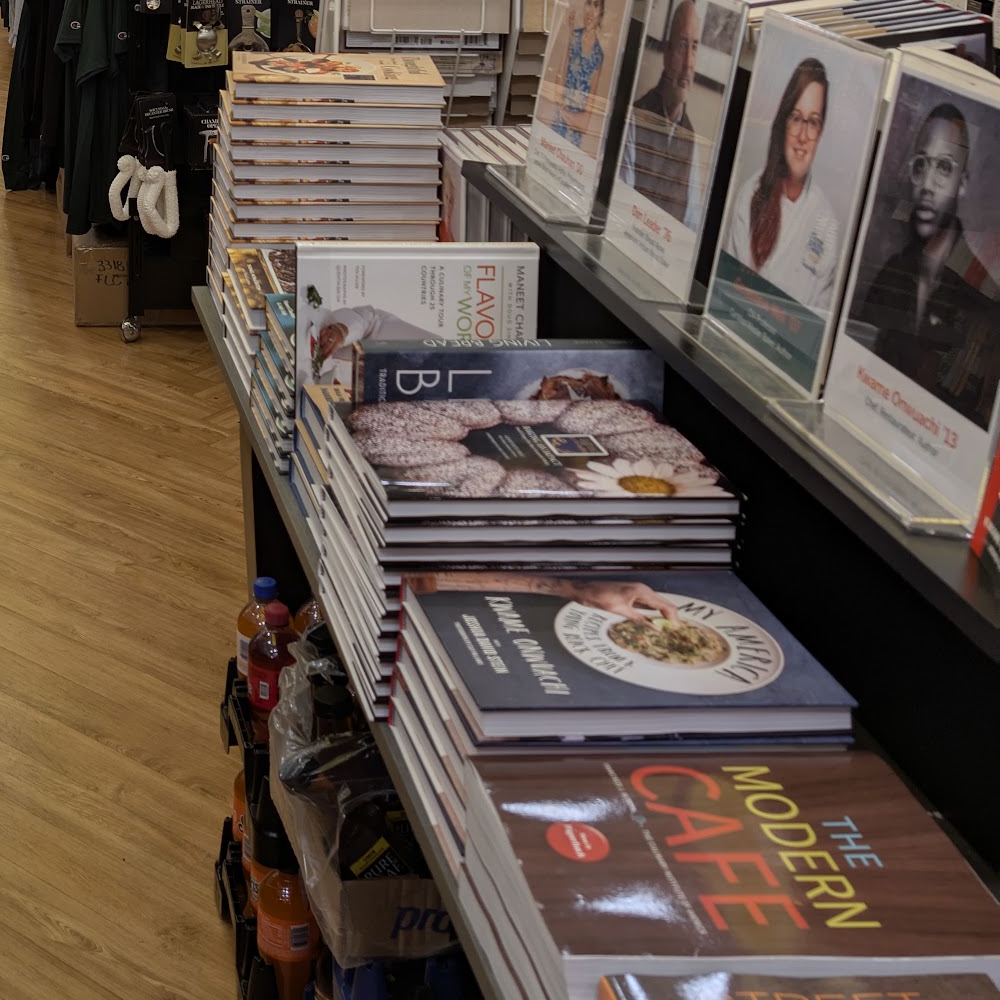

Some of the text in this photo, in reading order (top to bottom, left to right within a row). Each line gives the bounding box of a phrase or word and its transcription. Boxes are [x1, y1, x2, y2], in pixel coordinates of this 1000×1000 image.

[96, 260, 126, 272] 3318
[456, 265, 473, 340] OF MY WOR
[475, 265, 496, 339] FLAVO
[516, 266, 526, 310] MANEET
[485, 596, 570, 695] KWAME ONWUACHI
[678, 601, 773, 684] MY AMERICA
[629, 765, 810, 930] CAFE
[721, 766, 882, 928] MODERN
[823, 816, 885, 869] THE
